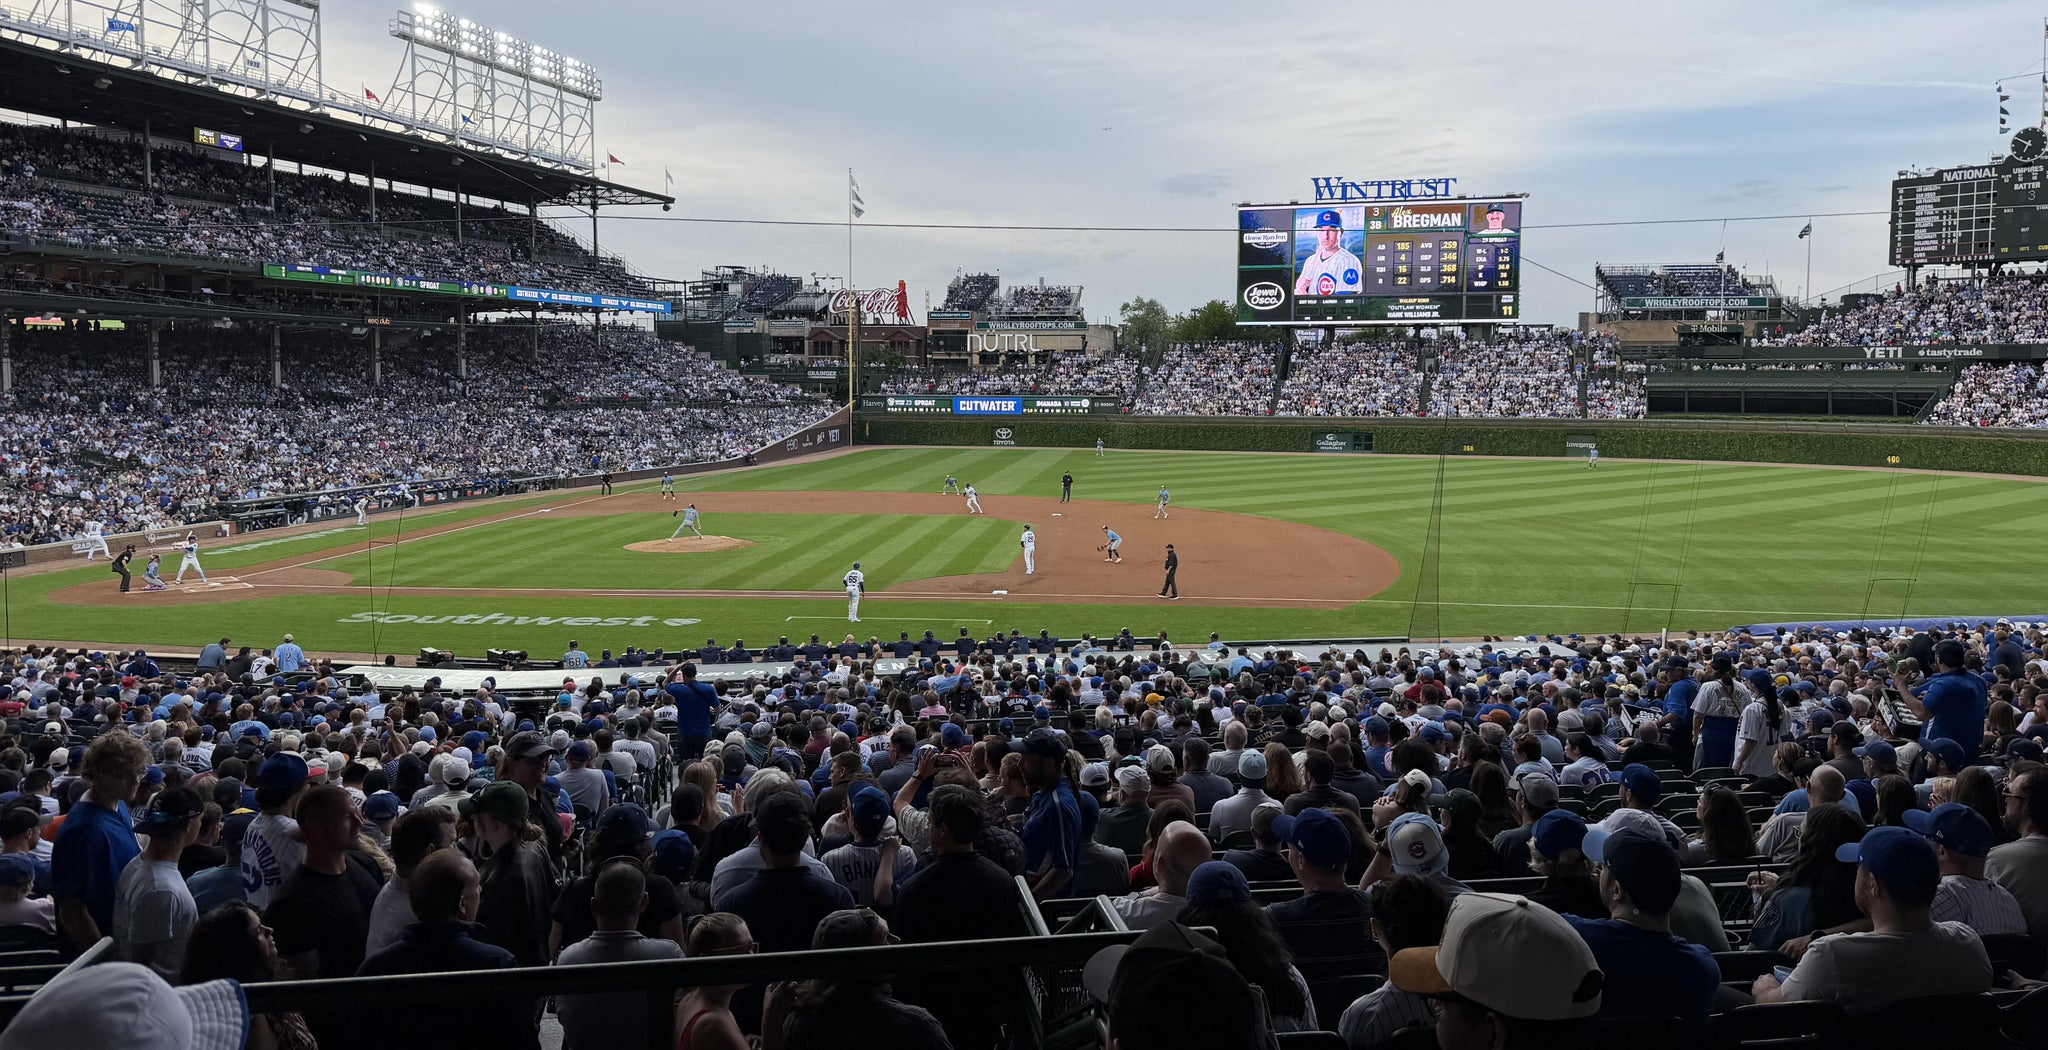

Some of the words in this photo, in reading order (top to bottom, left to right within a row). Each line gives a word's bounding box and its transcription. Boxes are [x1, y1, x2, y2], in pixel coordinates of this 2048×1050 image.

[1943, 167, 1998, 182] NATIONAL
[2013, 165, 2044, 175] UMPIRES
[1311, 176, 1457, 200] WINTRUST
[2014, 181, 2041, 191] BATTER
[2028, 190, 2036, 200] 3
[1372, 207, 1380, 217] 3
[1391, 206, 1412, 218] Alex
[1369, 220, 1382, 230] 3B
[1393, 213, 1462, 228] BREGMAN
[1441, 242, 1457, 250] .259
[1400, 253, 1406, 261] 4
[1441, 253, 1457, 261] .346
[1398, 265, 1407, 273] 16
[1440, 264, 1457, 272] .368
[1440, 276, 1456, 284] .714
[420, 281, 440, 290] SPROAT
[1249, 287, 1278, 297] Jewel
[1502, 306, 1512, 316] 11
[989, 321, 1075, 329] WRIGLEYROOFTOPS.COM
[1863, 346, 1903, 358] YETI
[1925, 348, 1983, 358] tastytrade
[863, 399, 885, 408] Harvey
[960, 400, 1016, 411] CUTWATER
[829, 429, 840, 443] YETI
[1566, 441, 1597, 449] Invenergy
[337, 611, 659, 627] Southwest
[286, 653, 292, 662] 2
[569, 658, 581, 667] 68
